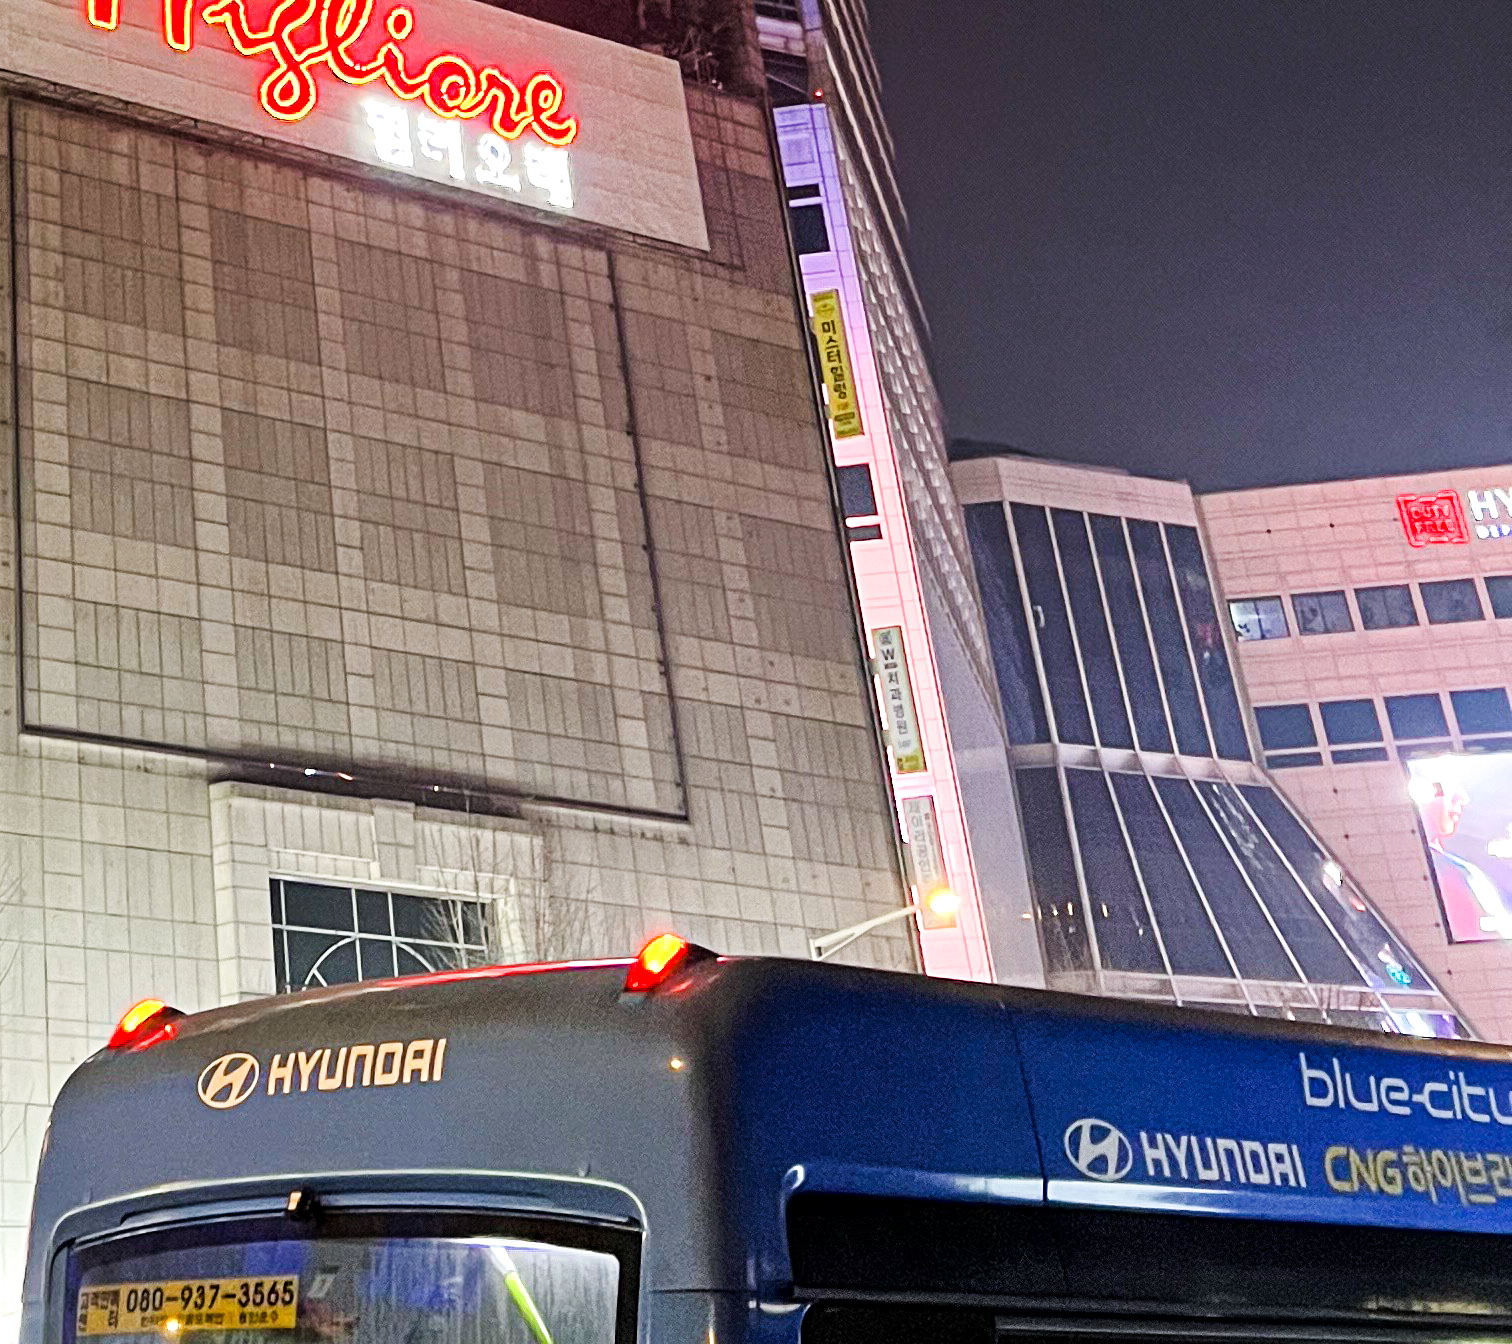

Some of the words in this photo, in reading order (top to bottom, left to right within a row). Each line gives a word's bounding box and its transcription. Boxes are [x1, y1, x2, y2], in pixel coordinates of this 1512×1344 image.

[267, 1039, 447, 1095] HYUNDAI
[1140, 1131, 1307, 1188] HYUNDAI
[126, 1280, 295, 1313] 080-937-3565
